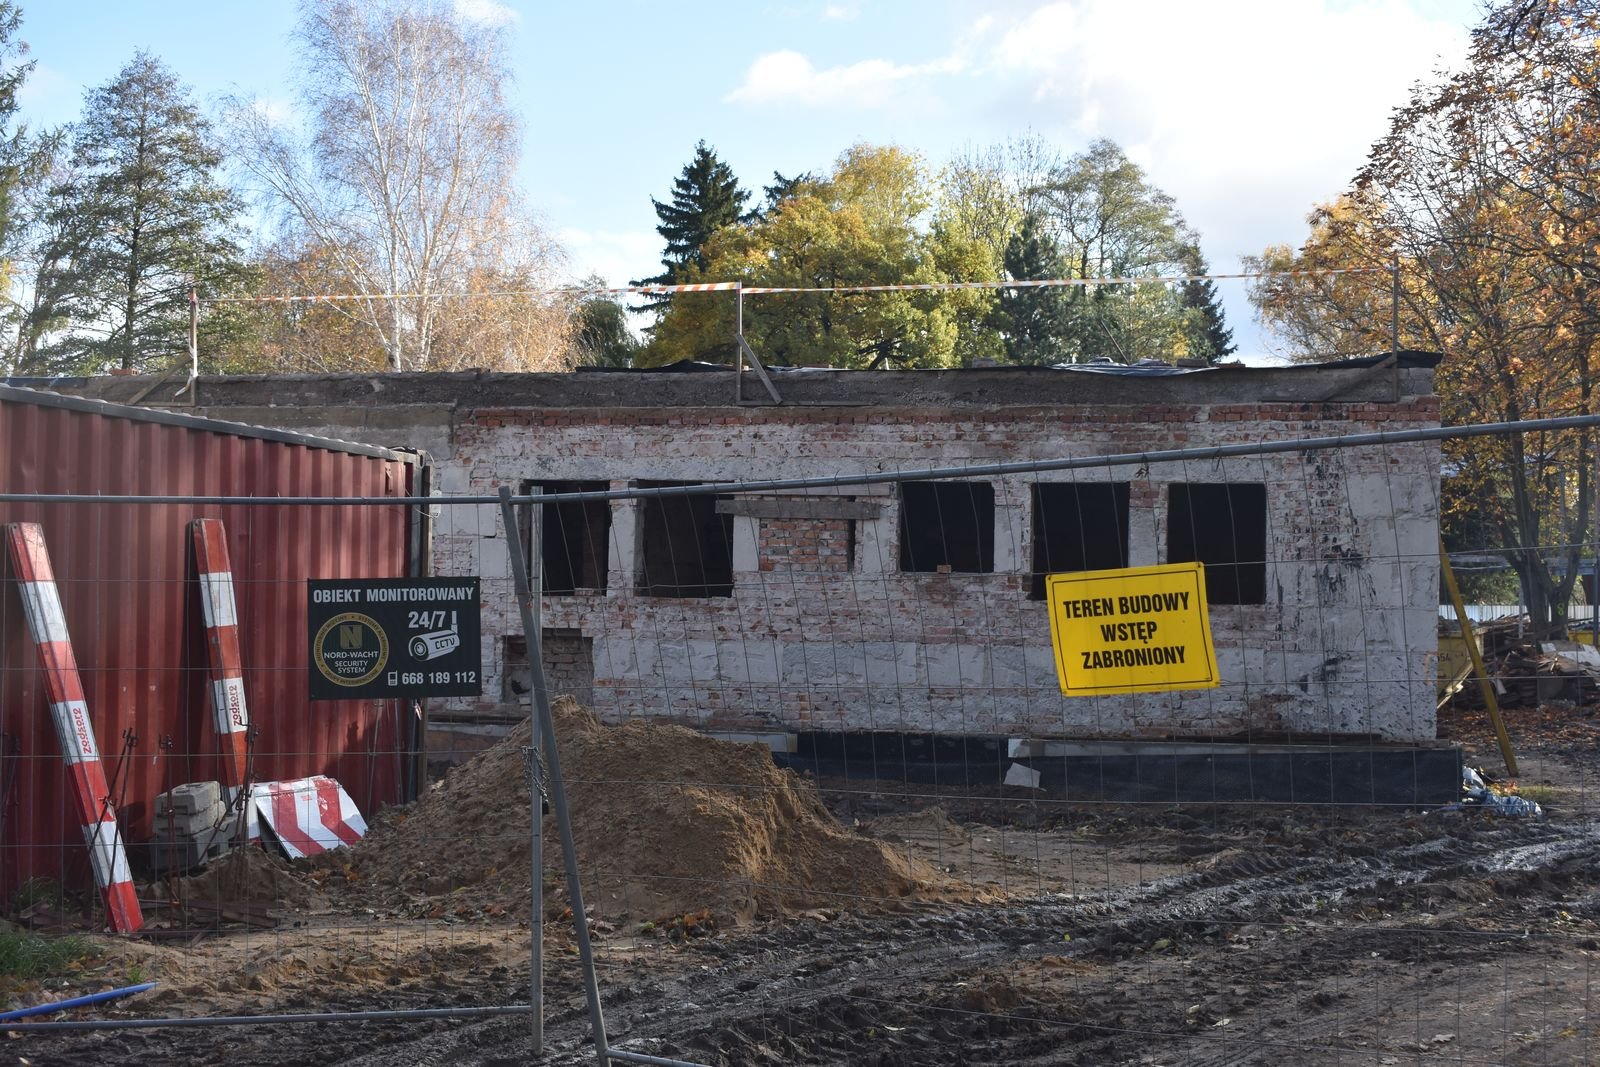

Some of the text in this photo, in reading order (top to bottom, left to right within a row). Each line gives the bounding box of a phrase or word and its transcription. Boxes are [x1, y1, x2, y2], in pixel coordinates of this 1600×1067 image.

[313, 587, 474, 603] OBIEKT MONITOROWANY
[1063, 592, 1190, 619] TEREN BUDOWY
[408, 611, 446, 629] 24/7
[1100, 621, 1158, 644] WSTĘP
[434, 638, 455, 650] CCTV
[324, 651, 379, 659] NORD-WACHT
[1081, 646, 1185, 669] ZABRONIONY
[402, 671, 476, 685] 668 189 112
